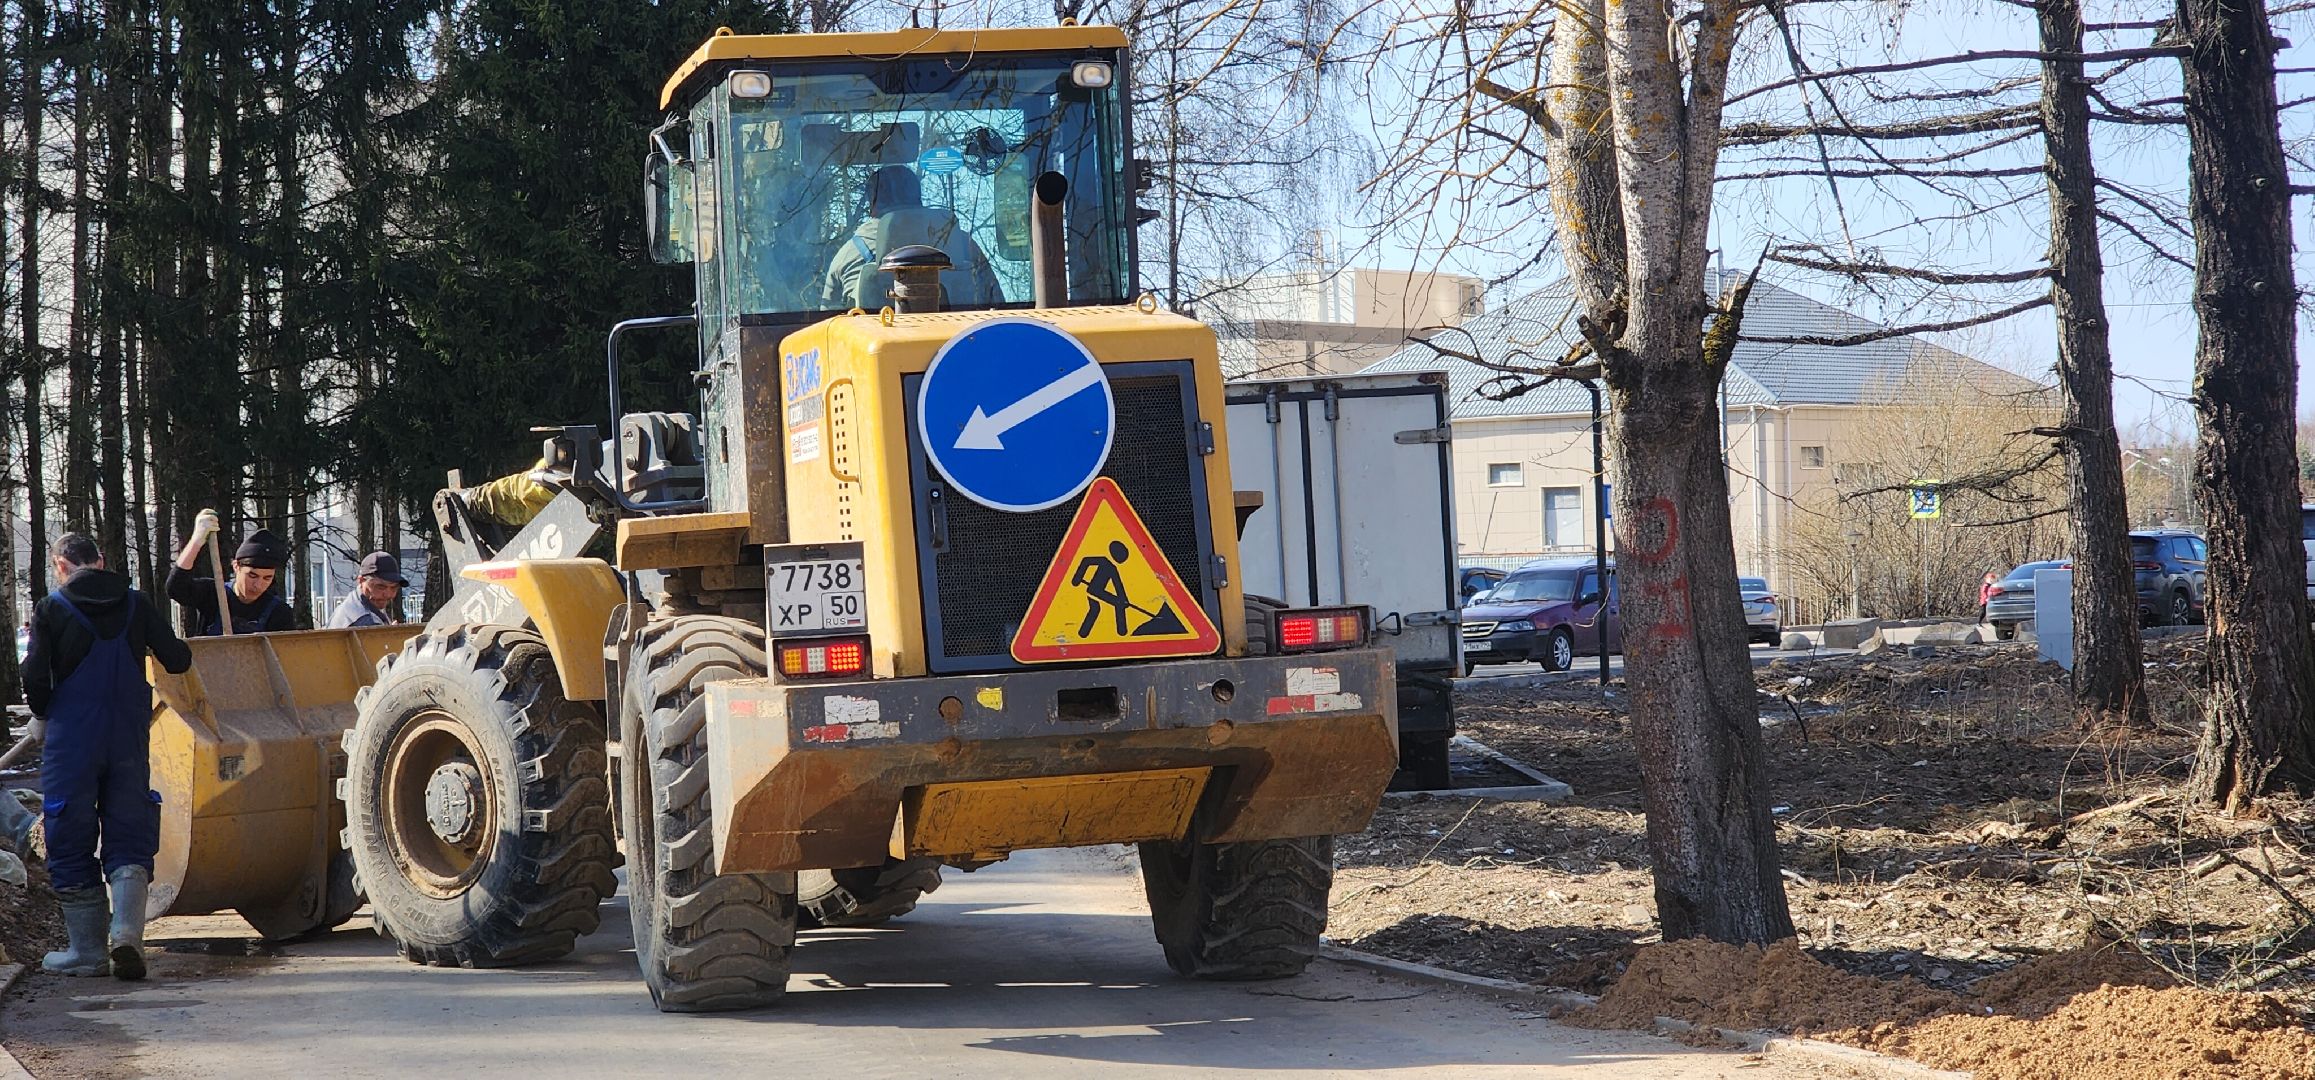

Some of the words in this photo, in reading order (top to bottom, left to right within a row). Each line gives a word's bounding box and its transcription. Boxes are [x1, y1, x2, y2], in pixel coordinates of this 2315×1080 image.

[781, 563, 851, 592] 7738
[778, 604, 812, 626] ХР
[830, 595, 858, 616] 50
[825, 618, 847, 626] RUS
